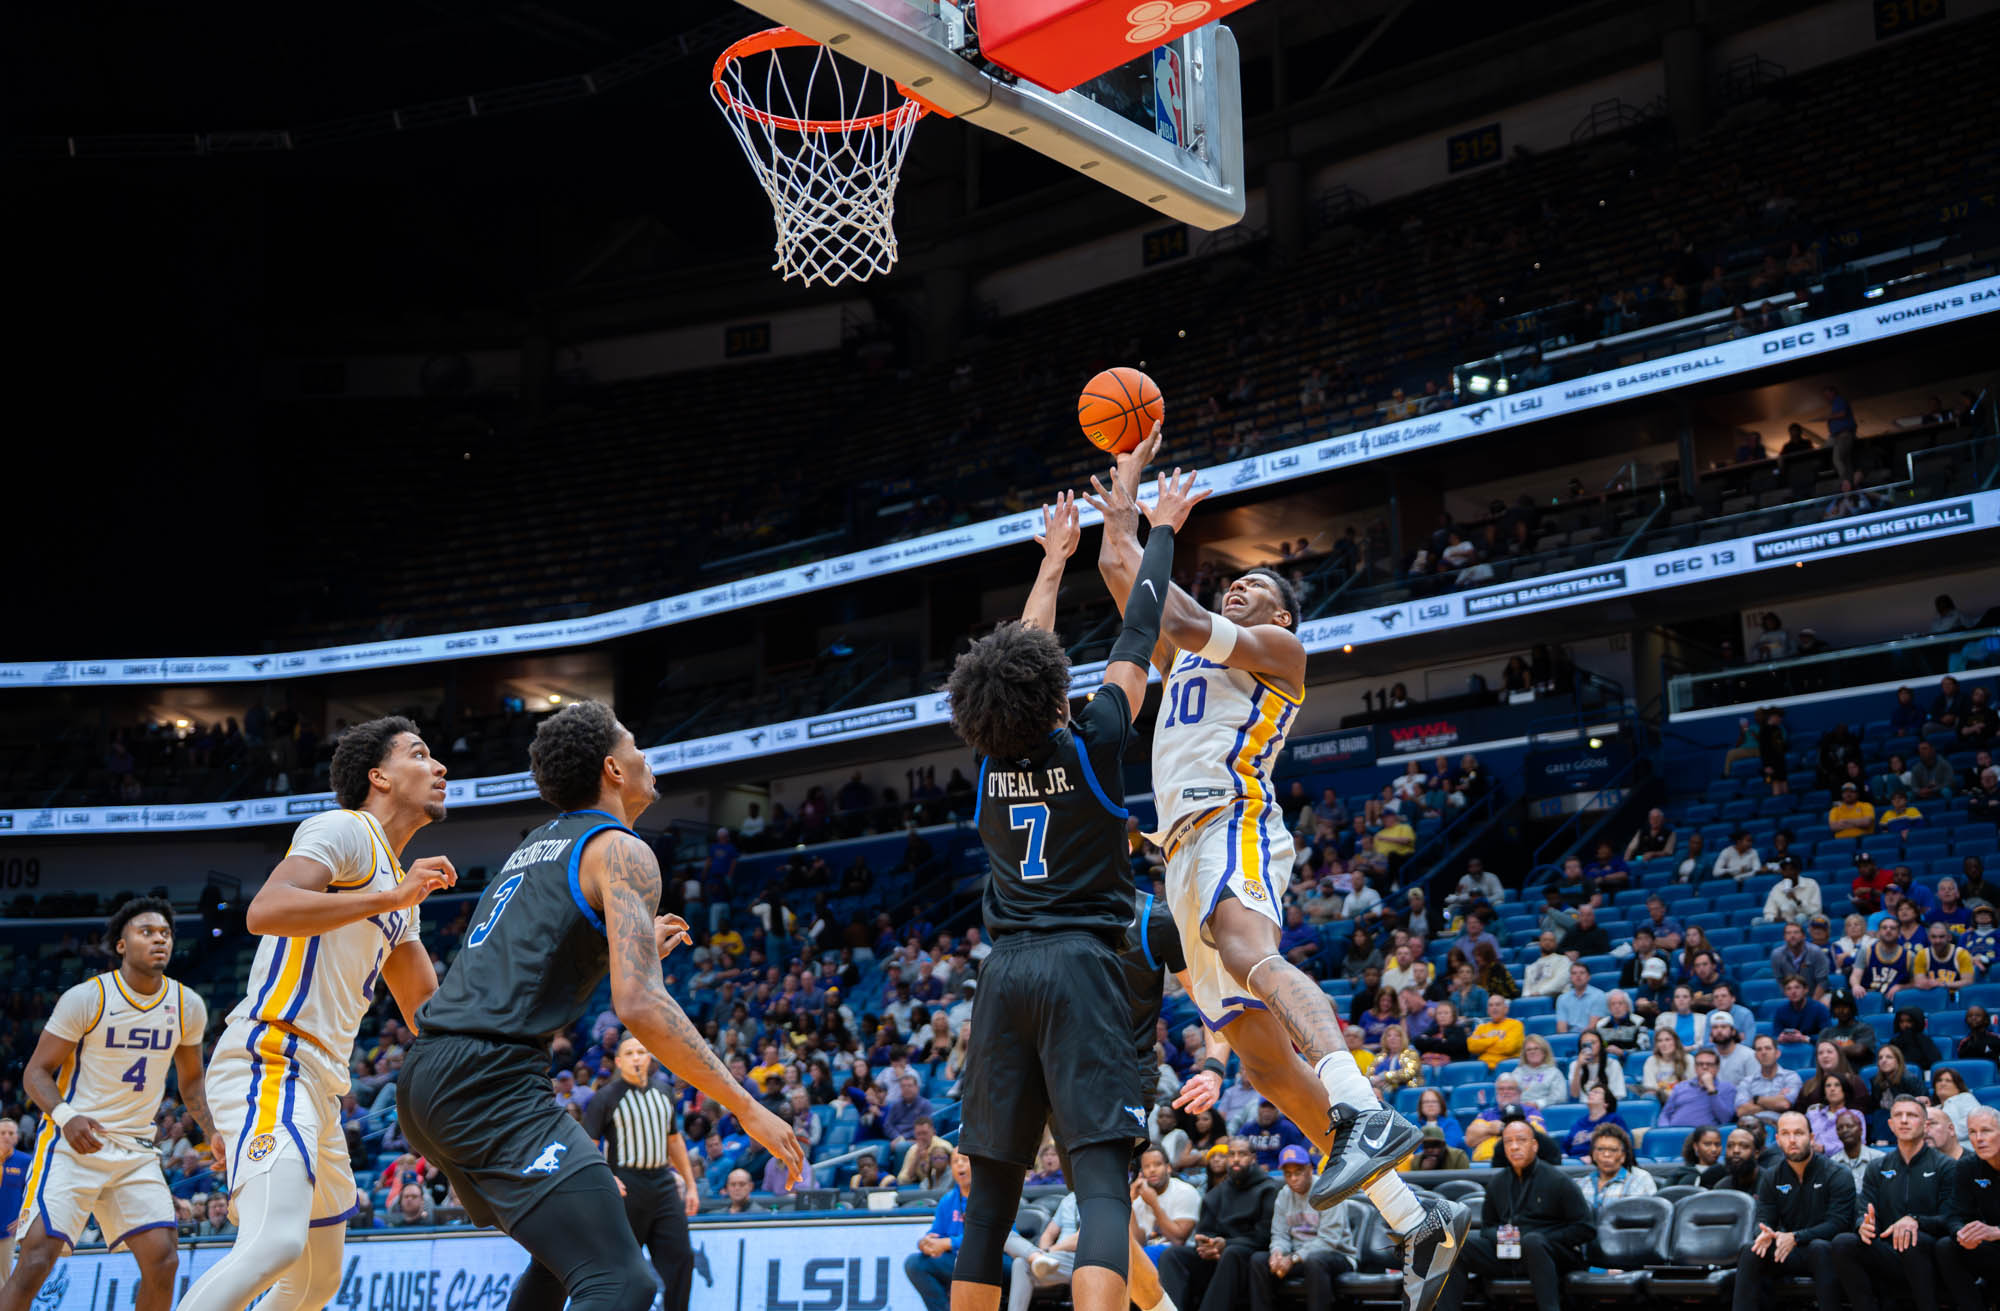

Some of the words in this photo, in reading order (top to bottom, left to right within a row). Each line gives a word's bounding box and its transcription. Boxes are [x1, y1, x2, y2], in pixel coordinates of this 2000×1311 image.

[1158, 119, 1176, 143] NBA
[1453, 134, 1497, 166] 315
[1147, 226, 1185, 261] 314
[1876, 296, 1964, 325] WOMEN'S
[1763, 332, 1815, 354] DEC
[1824, 323, 1850, 339] 13
[1565, 382, 1612, 400] MEN'S
[1616, 356, 1725, 388] BASKETBALL
[1509, 396, 1544, 414] LSU
[1271, 454, 1299, 471] LSU
[999, 518, 1032, 535] DEC
[1757, 532, 1841, 557] WOMEN'S
[1844, 508, 1969, 539] BASKETBALL
[832, 560, 855, 575] LSU
[1654, 557, 1703, 577] DEC
[1711, 551, 1736, 565] 13
[1469, 594, 1517, 611] MEN'S
[1518, 573, 1623, 598] BASKETBALL
[1418, 604, 1449, 620] LSU
[445, 638, 478, 649] DEC
[482, 635, 499, 645] 13
[79, 664, 107, 676] LSU
[281, 657, 305, 667] LSU
[1164, 675, 1208, 729] 10
[775, 727, 798, 741] LSU
[1388, 719, 1457, 742] WWL
[988, 771, 1039, 798] O'NEAL
[1045, 767, 1075, 795] JR.
[64, 813, 90, 824] LSU
[255, 805, 277, 815] LSU
[1009, 801, 1050, 880] 7
[467, 872, 525, 949] 3
[1872, 966, 1898, 983] LSU
[105, 1026, 174, 1051] LSU
[121, 1056, 148, 1093] 4
[336, 1254, 362, 1311] 4
[368, 1269, 441, 1311] CAUSE
[445, 1267, 511, 1311] CLAS
[765, 1256, 891, 1311] LSU
